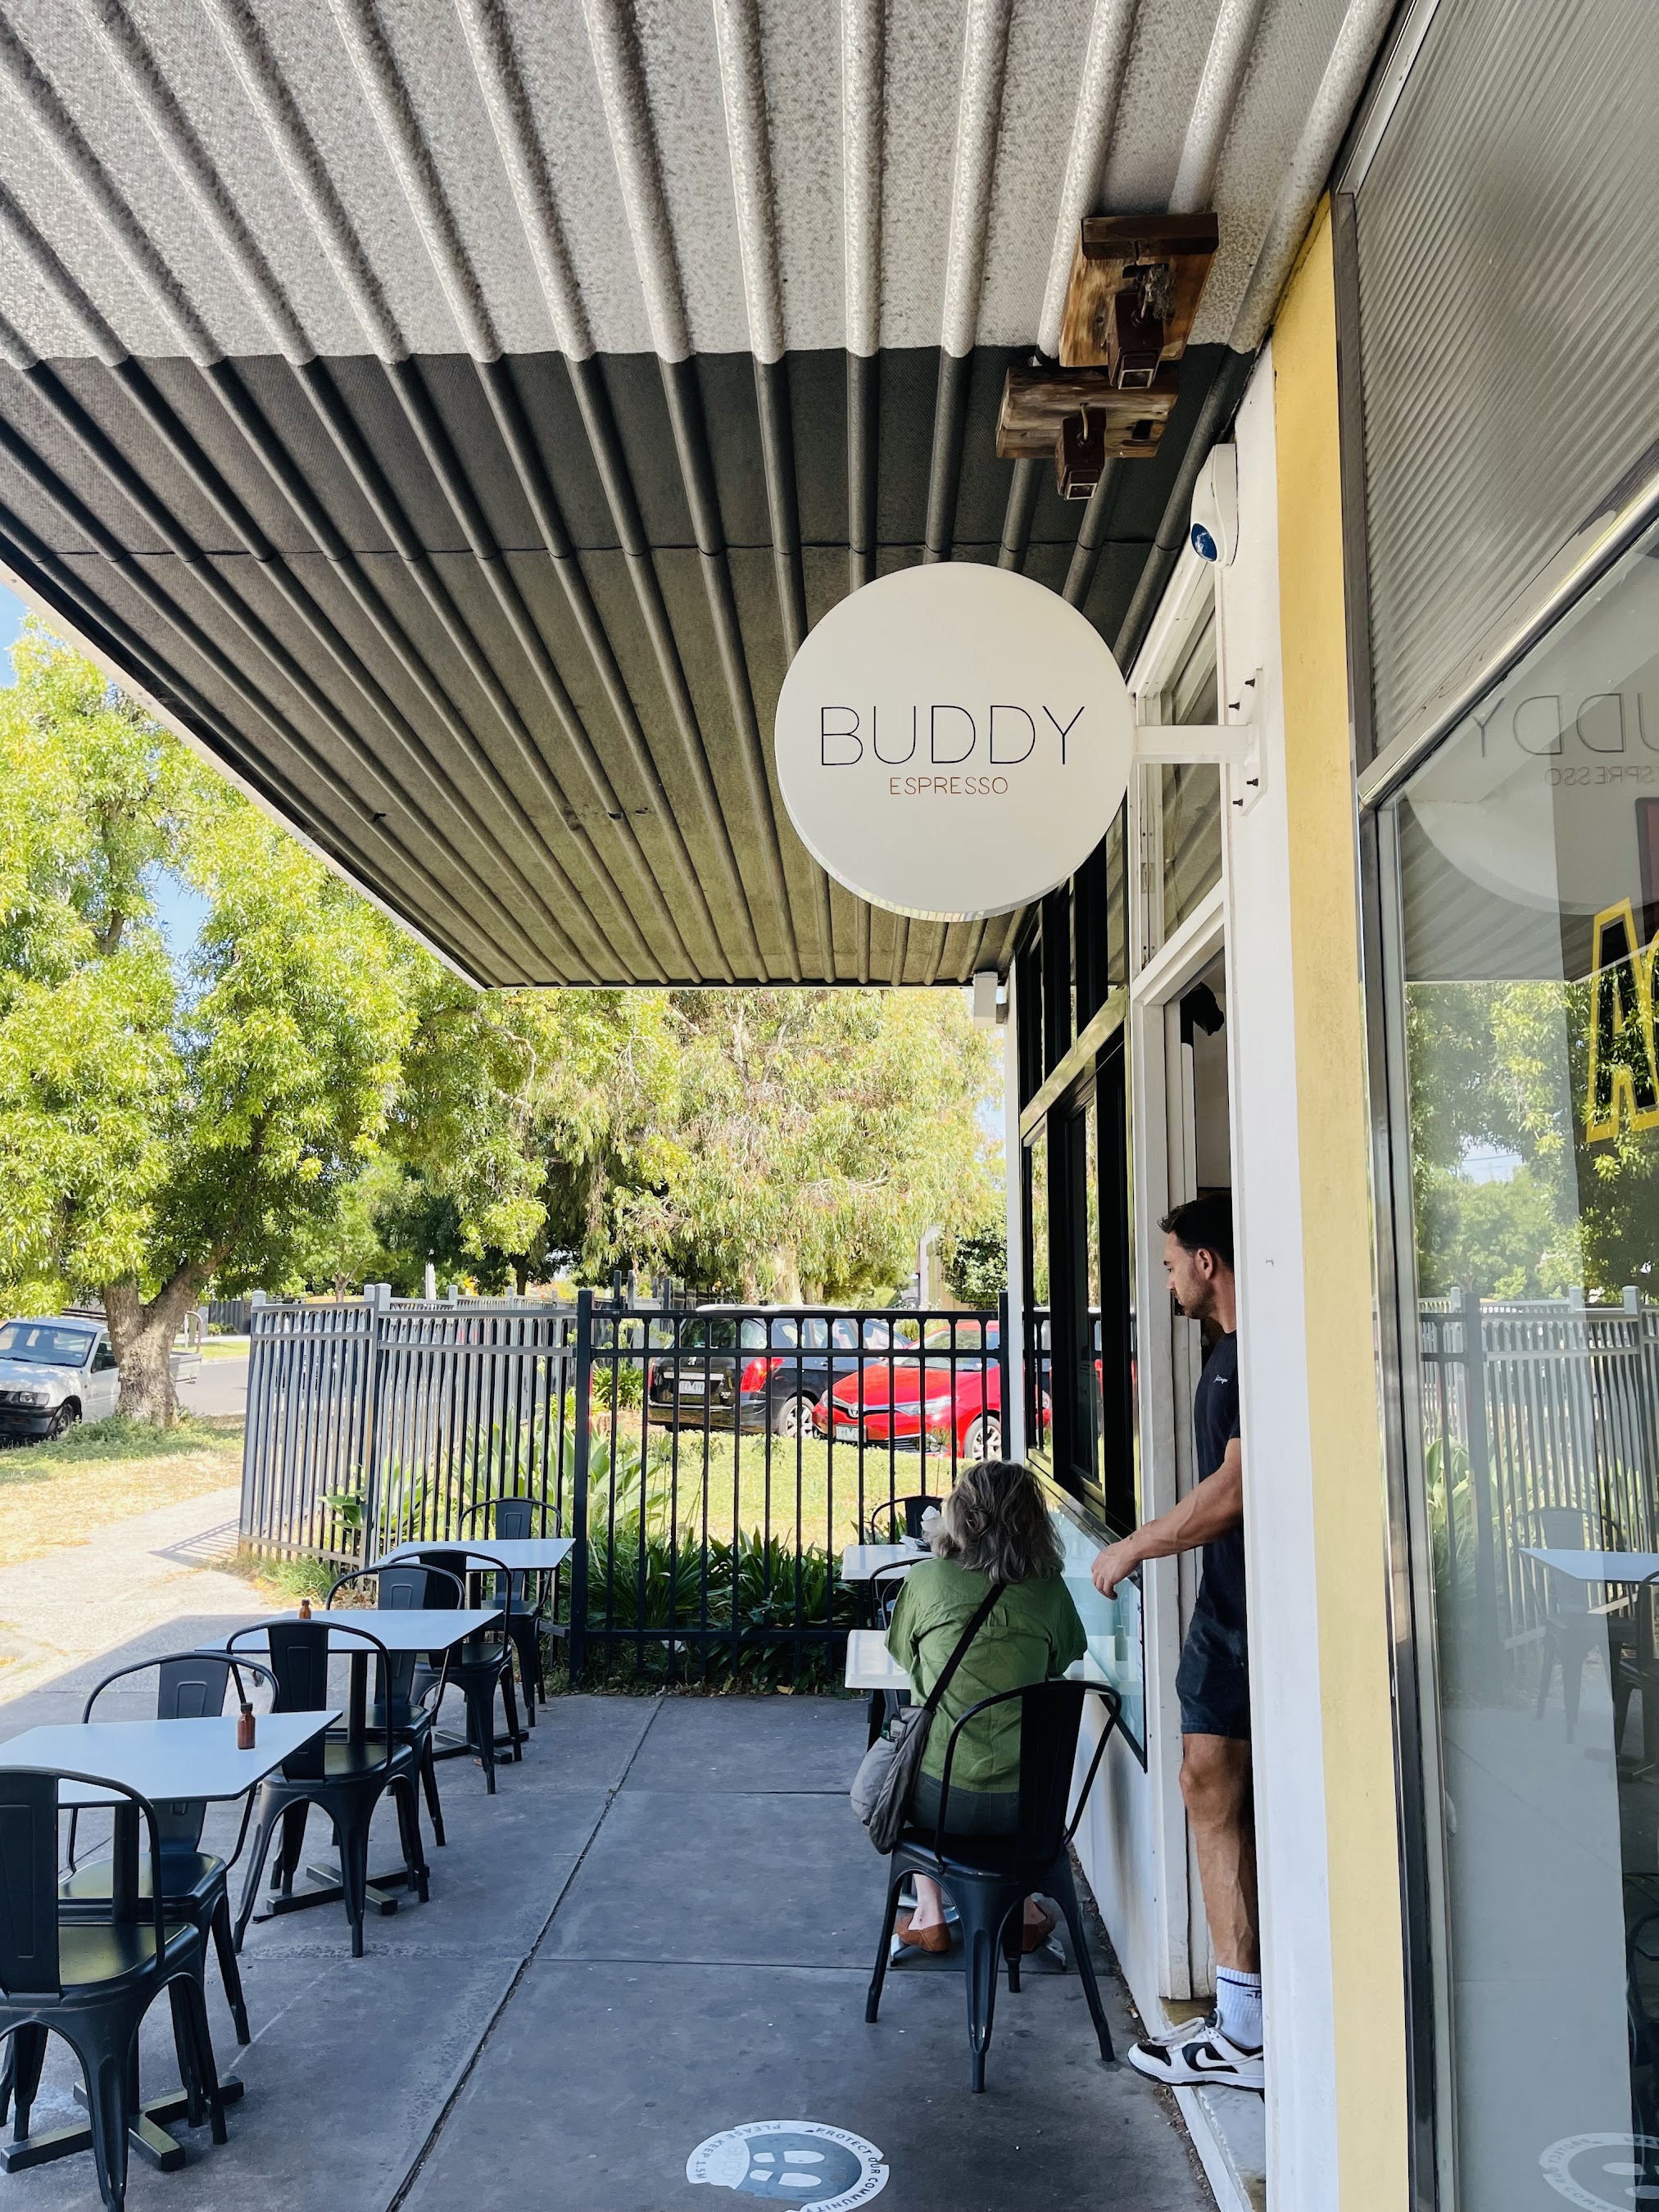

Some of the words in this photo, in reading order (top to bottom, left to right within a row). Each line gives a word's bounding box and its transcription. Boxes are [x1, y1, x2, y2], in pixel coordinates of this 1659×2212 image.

[821, 705, 1086, 766] BUDDY
[890, 777, 1009, 796] ESPRESSO
[726, 2124, 781, 2140] PLEASE
[701, 2139, 725, 2158] KEEP
[816, 2128, 873, 2155] PROTECT
[868, 2157, 881, 2174] OUR
[695, 2160, 707, 2179] 1.5M
